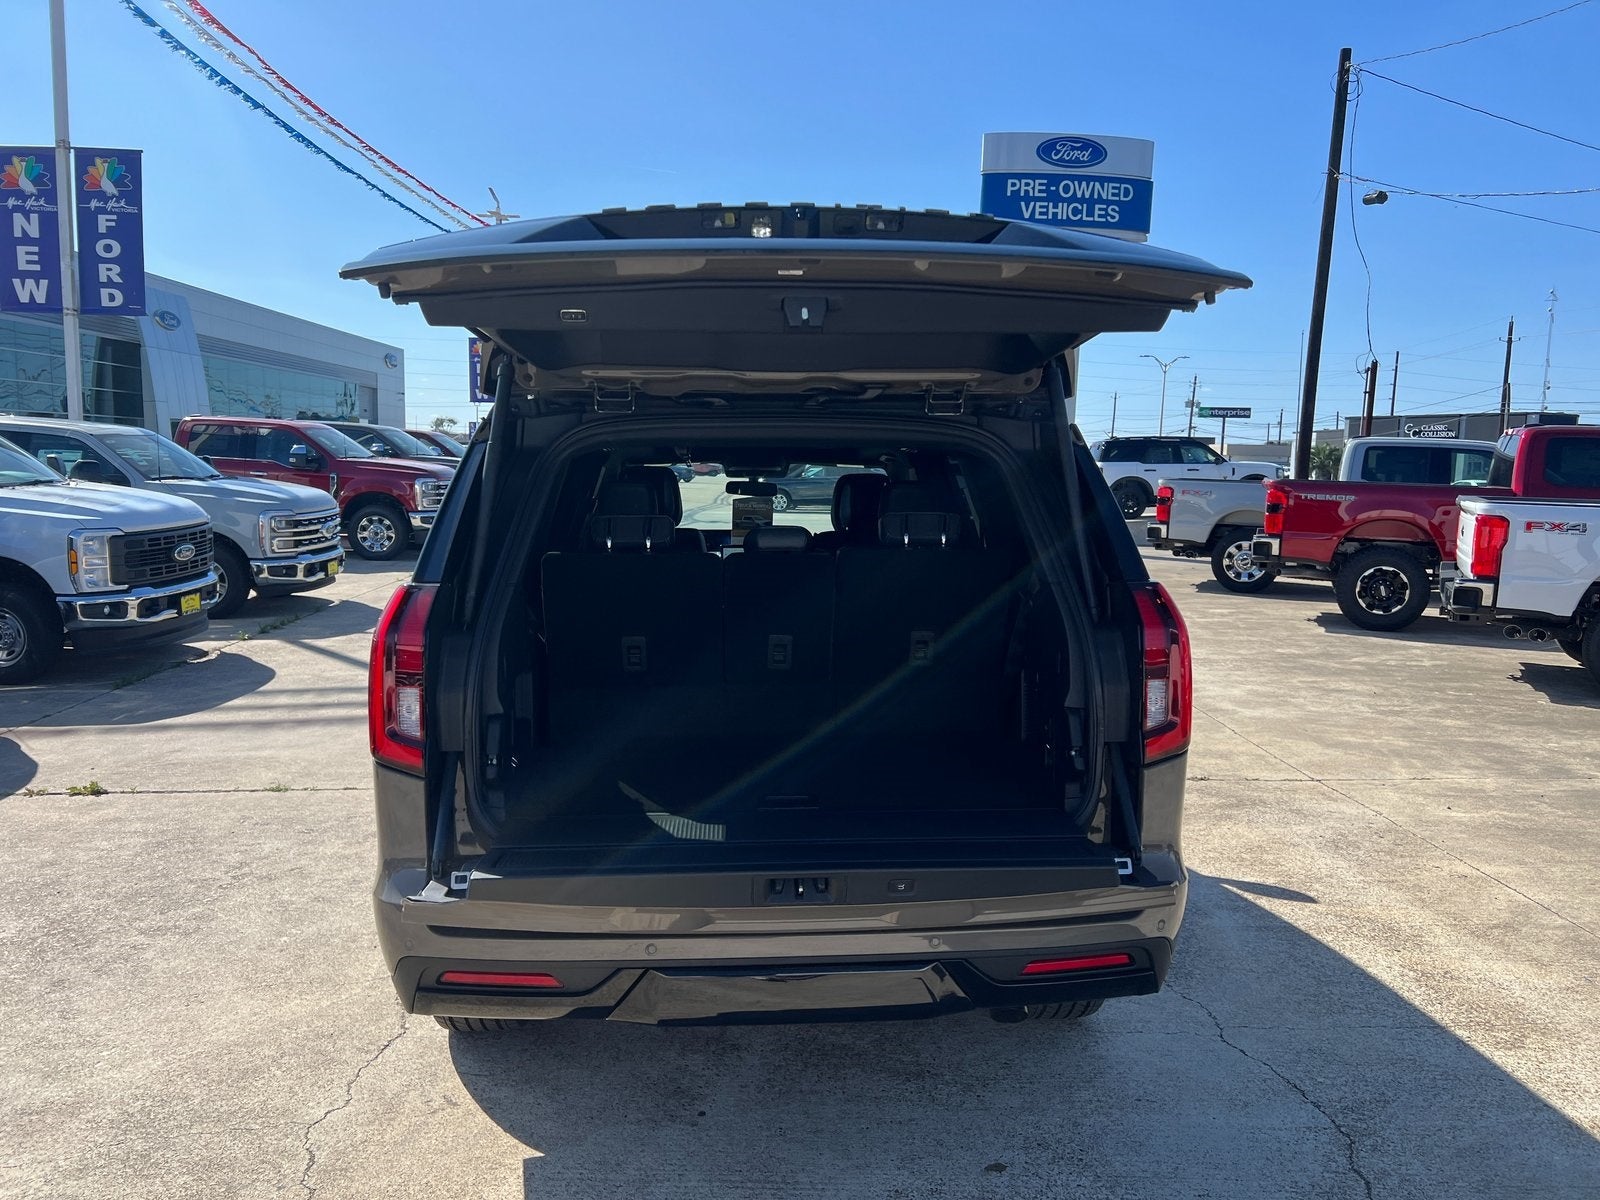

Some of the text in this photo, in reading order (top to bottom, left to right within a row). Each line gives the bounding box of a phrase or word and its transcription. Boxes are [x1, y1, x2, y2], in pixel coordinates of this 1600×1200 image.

[1051, 141, 1093, 161] Ford
[1006, 179, 1134, 201] PRE-OWNED
[1020, 202, 1120, 223] VEHICLES
[12, 212, 49, 304] NEW
[95, 214, 124, 307] FORD
[1181, 489, 1213, 497] FX4
[1300, 493, 1356, 502] TREMOR
[1523, 521, 1588, 534] FX4
